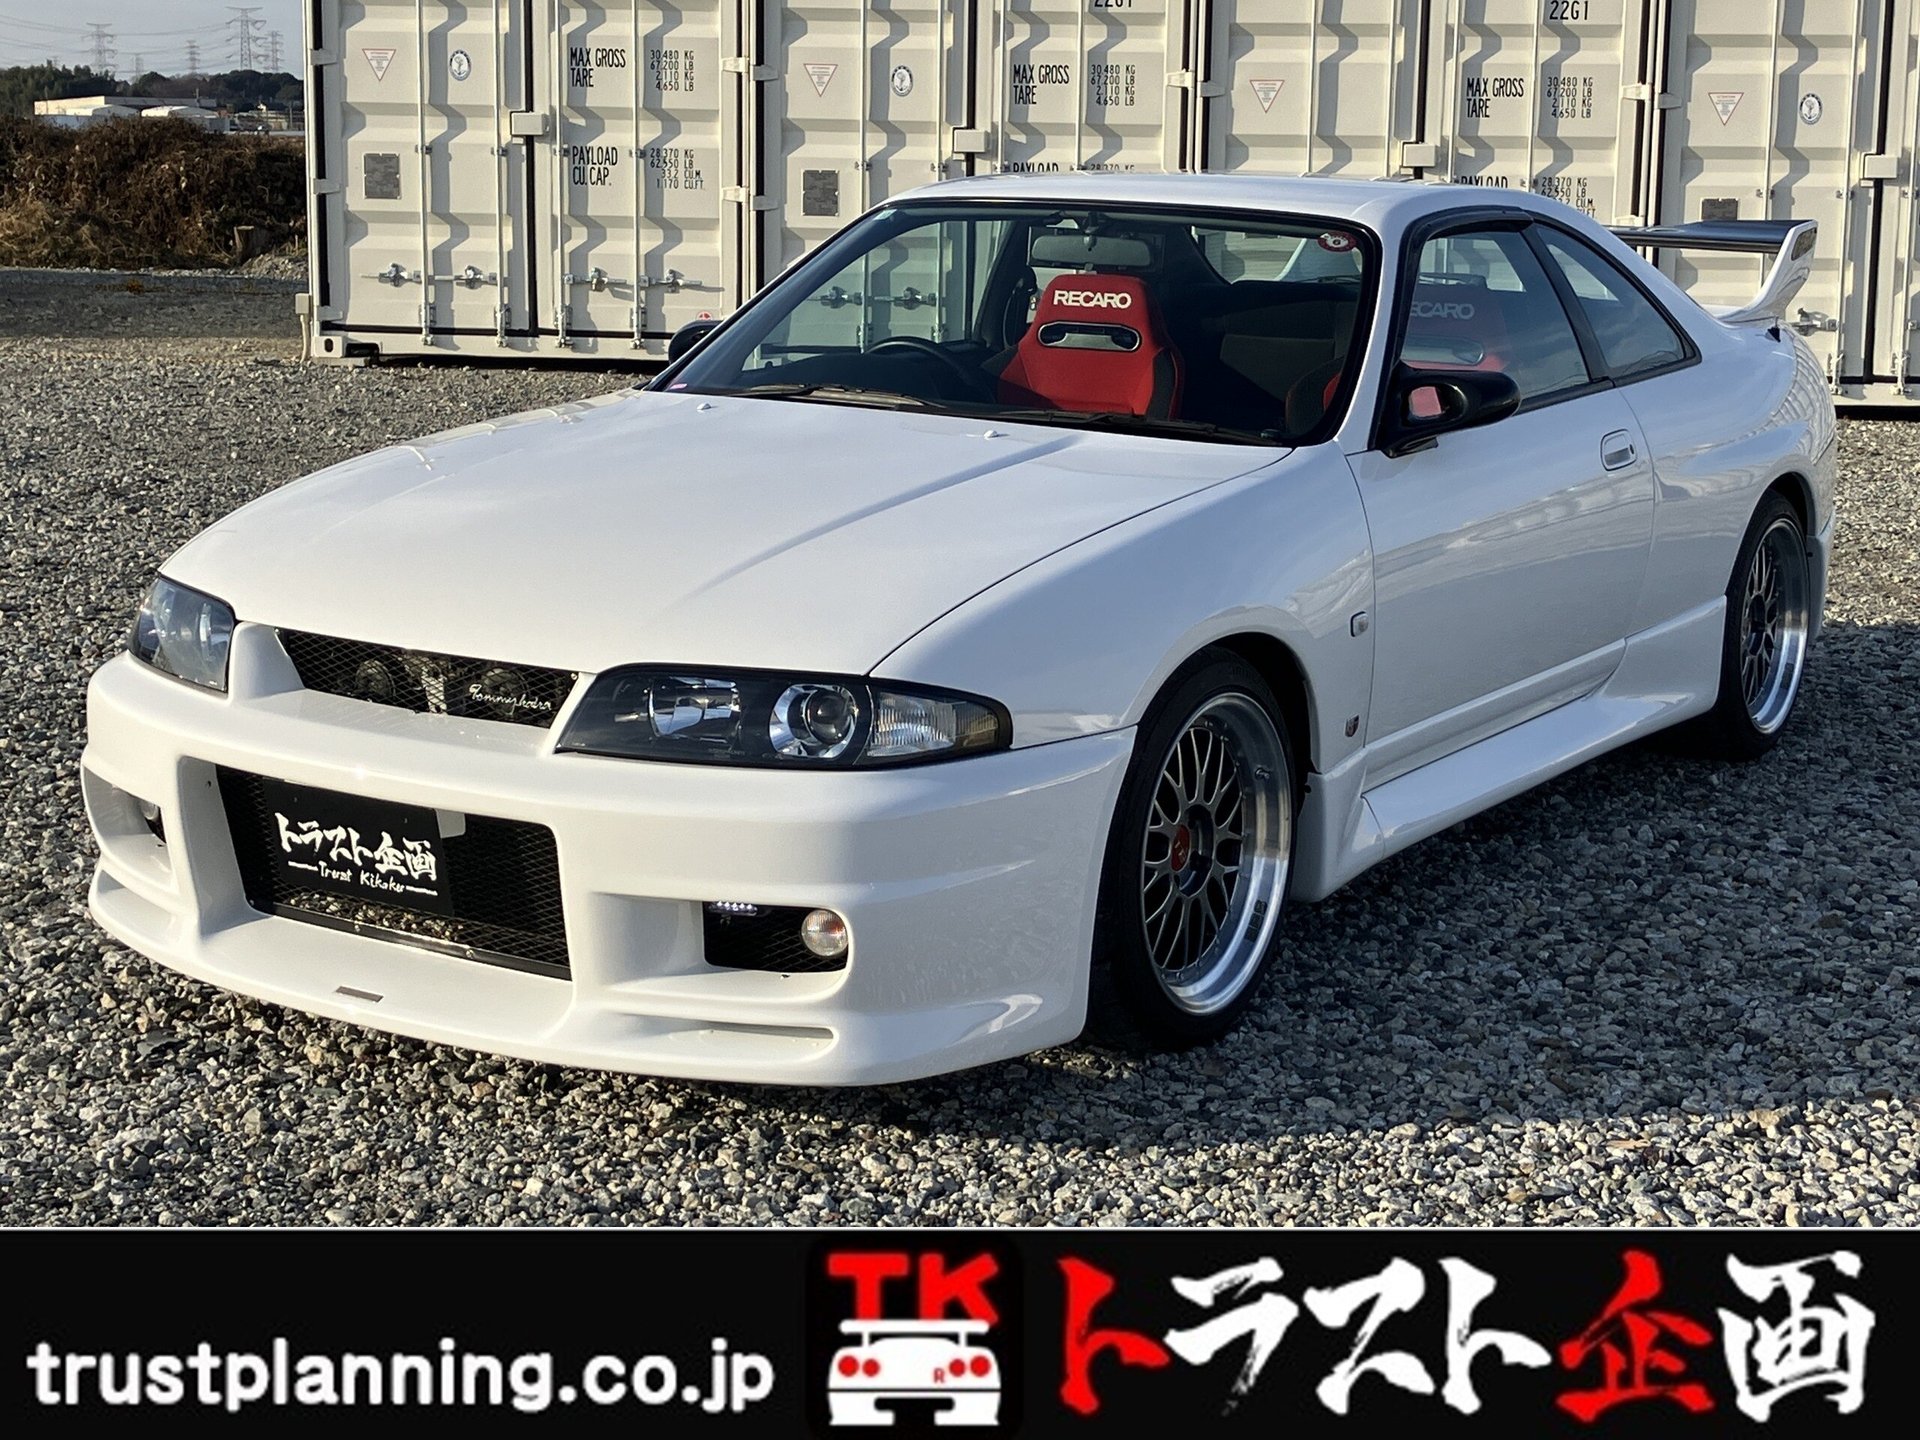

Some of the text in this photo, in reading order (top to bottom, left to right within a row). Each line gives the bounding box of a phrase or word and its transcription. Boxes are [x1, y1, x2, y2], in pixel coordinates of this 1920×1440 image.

[1549, 0, 1588, 20] 22G1
[570, 47, 626, 68] MAX GROSS
[684, 50, 694, 60] KG
[684, 61, 694, 71] LB
[1125, 64, 1135, 74] KG
[571, 68, 594, 87] TARE
[684, 71, 694, 81] KG
[1013, 64, 1069, 84] MAX GROSS
[1125, 75, 1135, 85] LB
[1582, 77, 1593, 87] KG
[684, 82, 694, 91] LB
[1125, 86, 1135, 95] KG
[1466, 78, 1524, 97] MAX GROSS
[1013, 85, 1037, 104] TARE
[1582, 88, 1592, 97] LB
[1125, 96, 1135, 106] LB
[1581, 98, 1592, 108] KG
[1466, 98, 1491, 118] TARE
[1581, 108, 1591, 118] LB
[572, 146, 618, 165] PAYLOAD
[684, 149, 694, 159] KG
[684, 160, 694, 169] LB
[572, 166, 612, 186] CU. CAP.
[1577, 177, 1587, 187] KG
[1576, 188, 1586, 198] LB
[1053, 290, 1132, 309] RECARO
[1410, 301, 1475, 320] ECARO
[275, 812, 438, 881] トラスト企画
[318, 860, 405, 892] Trust Kikaku
